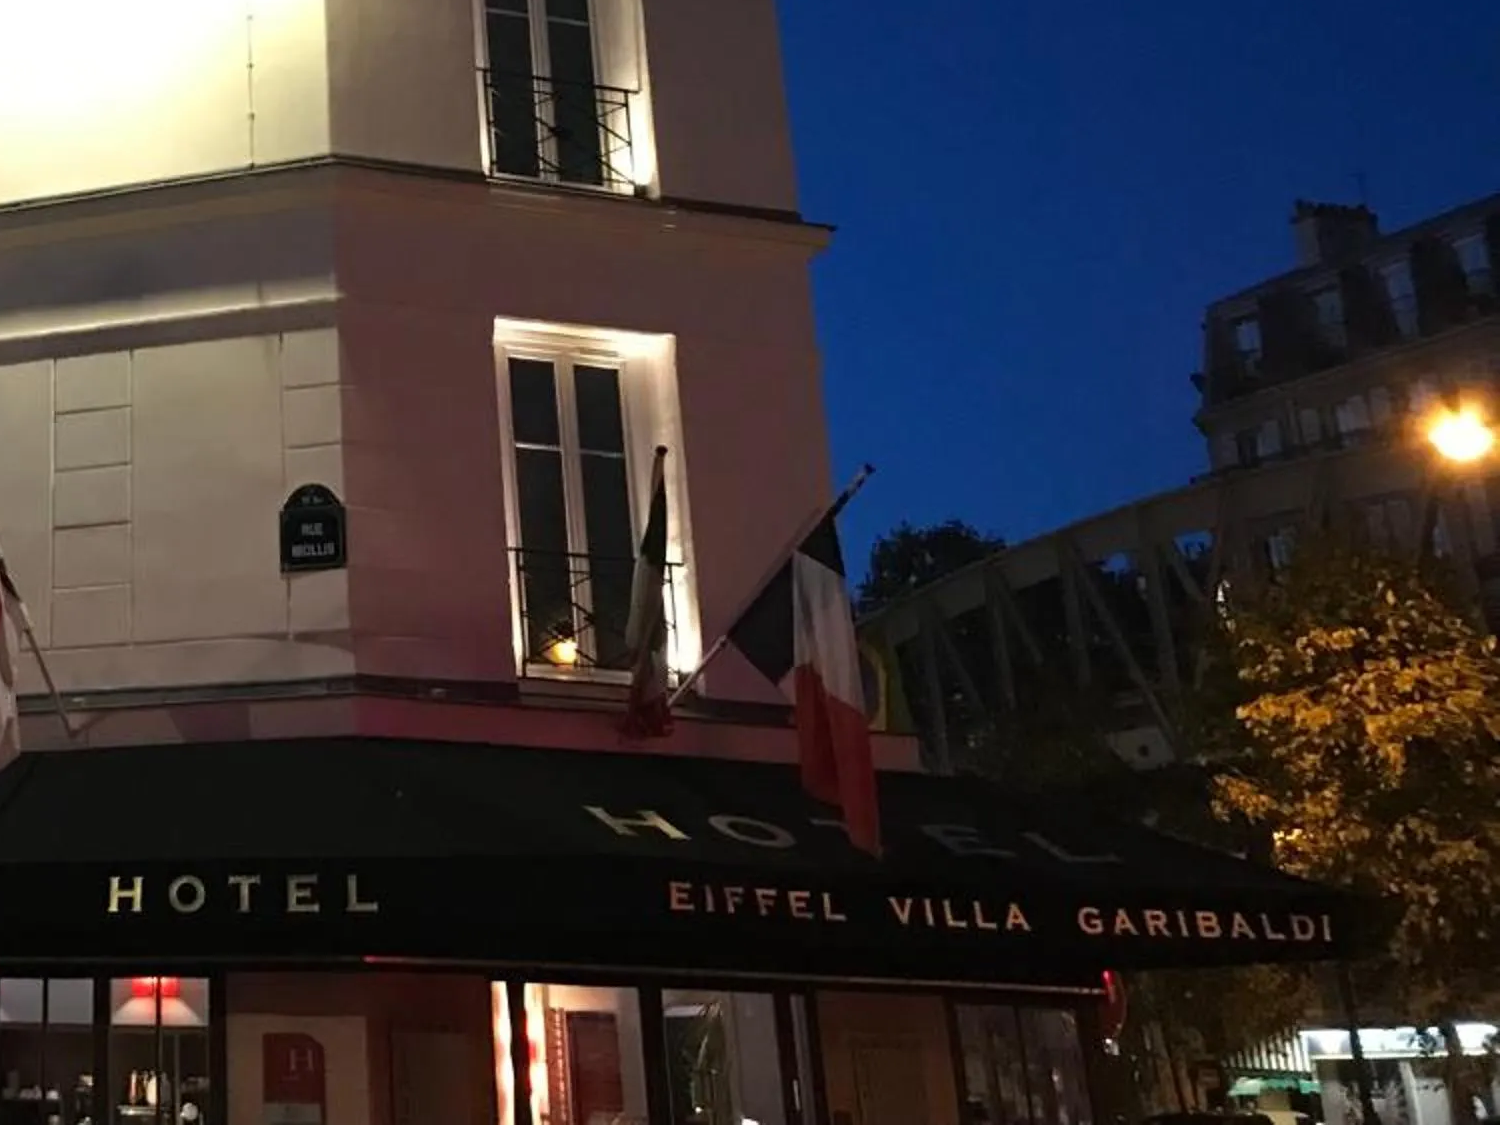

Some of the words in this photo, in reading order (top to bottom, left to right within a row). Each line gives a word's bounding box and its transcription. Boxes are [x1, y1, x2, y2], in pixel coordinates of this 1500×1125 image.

[107, 874, 379, 914] HOTEL
[669, 881, 847, 922] EIFFEL
[887, 896, 1032, 932] VILLA
[1077, 906, 1333, 942] GARIBALDI
